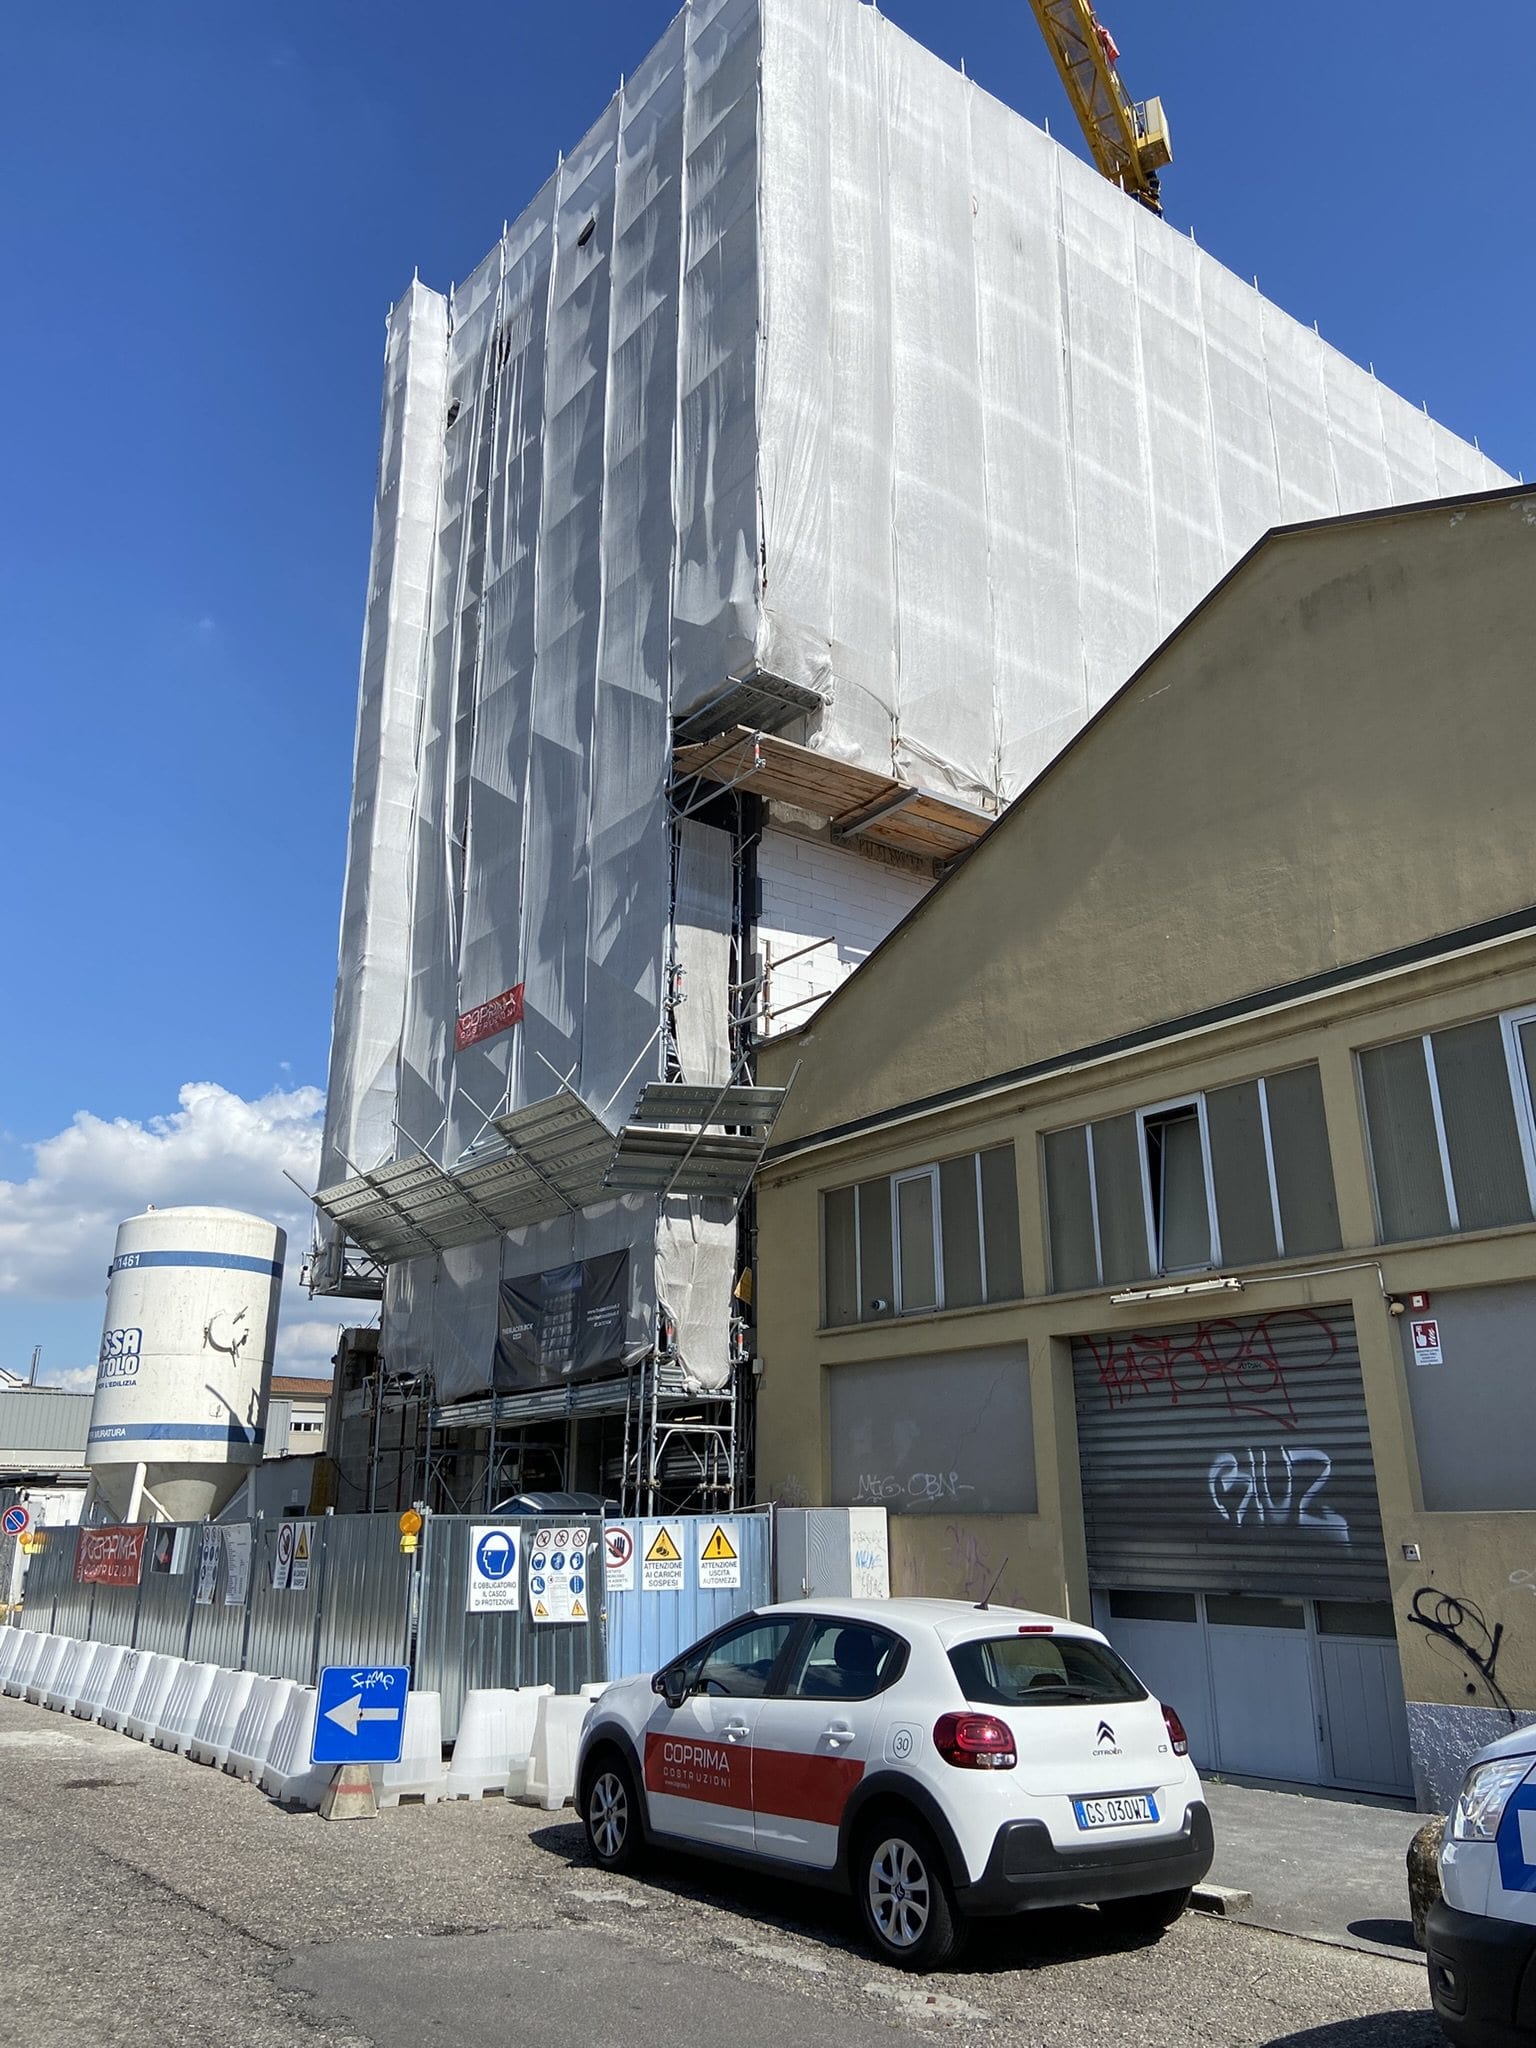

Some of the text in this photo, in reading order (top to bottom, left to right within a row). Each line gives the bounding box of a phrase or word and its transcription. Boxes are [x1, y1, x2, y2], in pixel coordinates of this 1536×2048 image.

[102, 1328, 142, 1357] SSA
[99, 1355, 139, 1378] TOLO
[701, 1561, 737, 1569] ATTENZIONE
[653, 1570, 682, 1578] CARICHI
[709, 1569, 731, 1577] USCITA
[648, 1579, 679, 1587] SOSPESI
[896, 1737, 909, 1751] 30
[663, 1742, 730, 1773] COPRIMA
[663, 1766, 731, 1788] COSTRUZIONI
